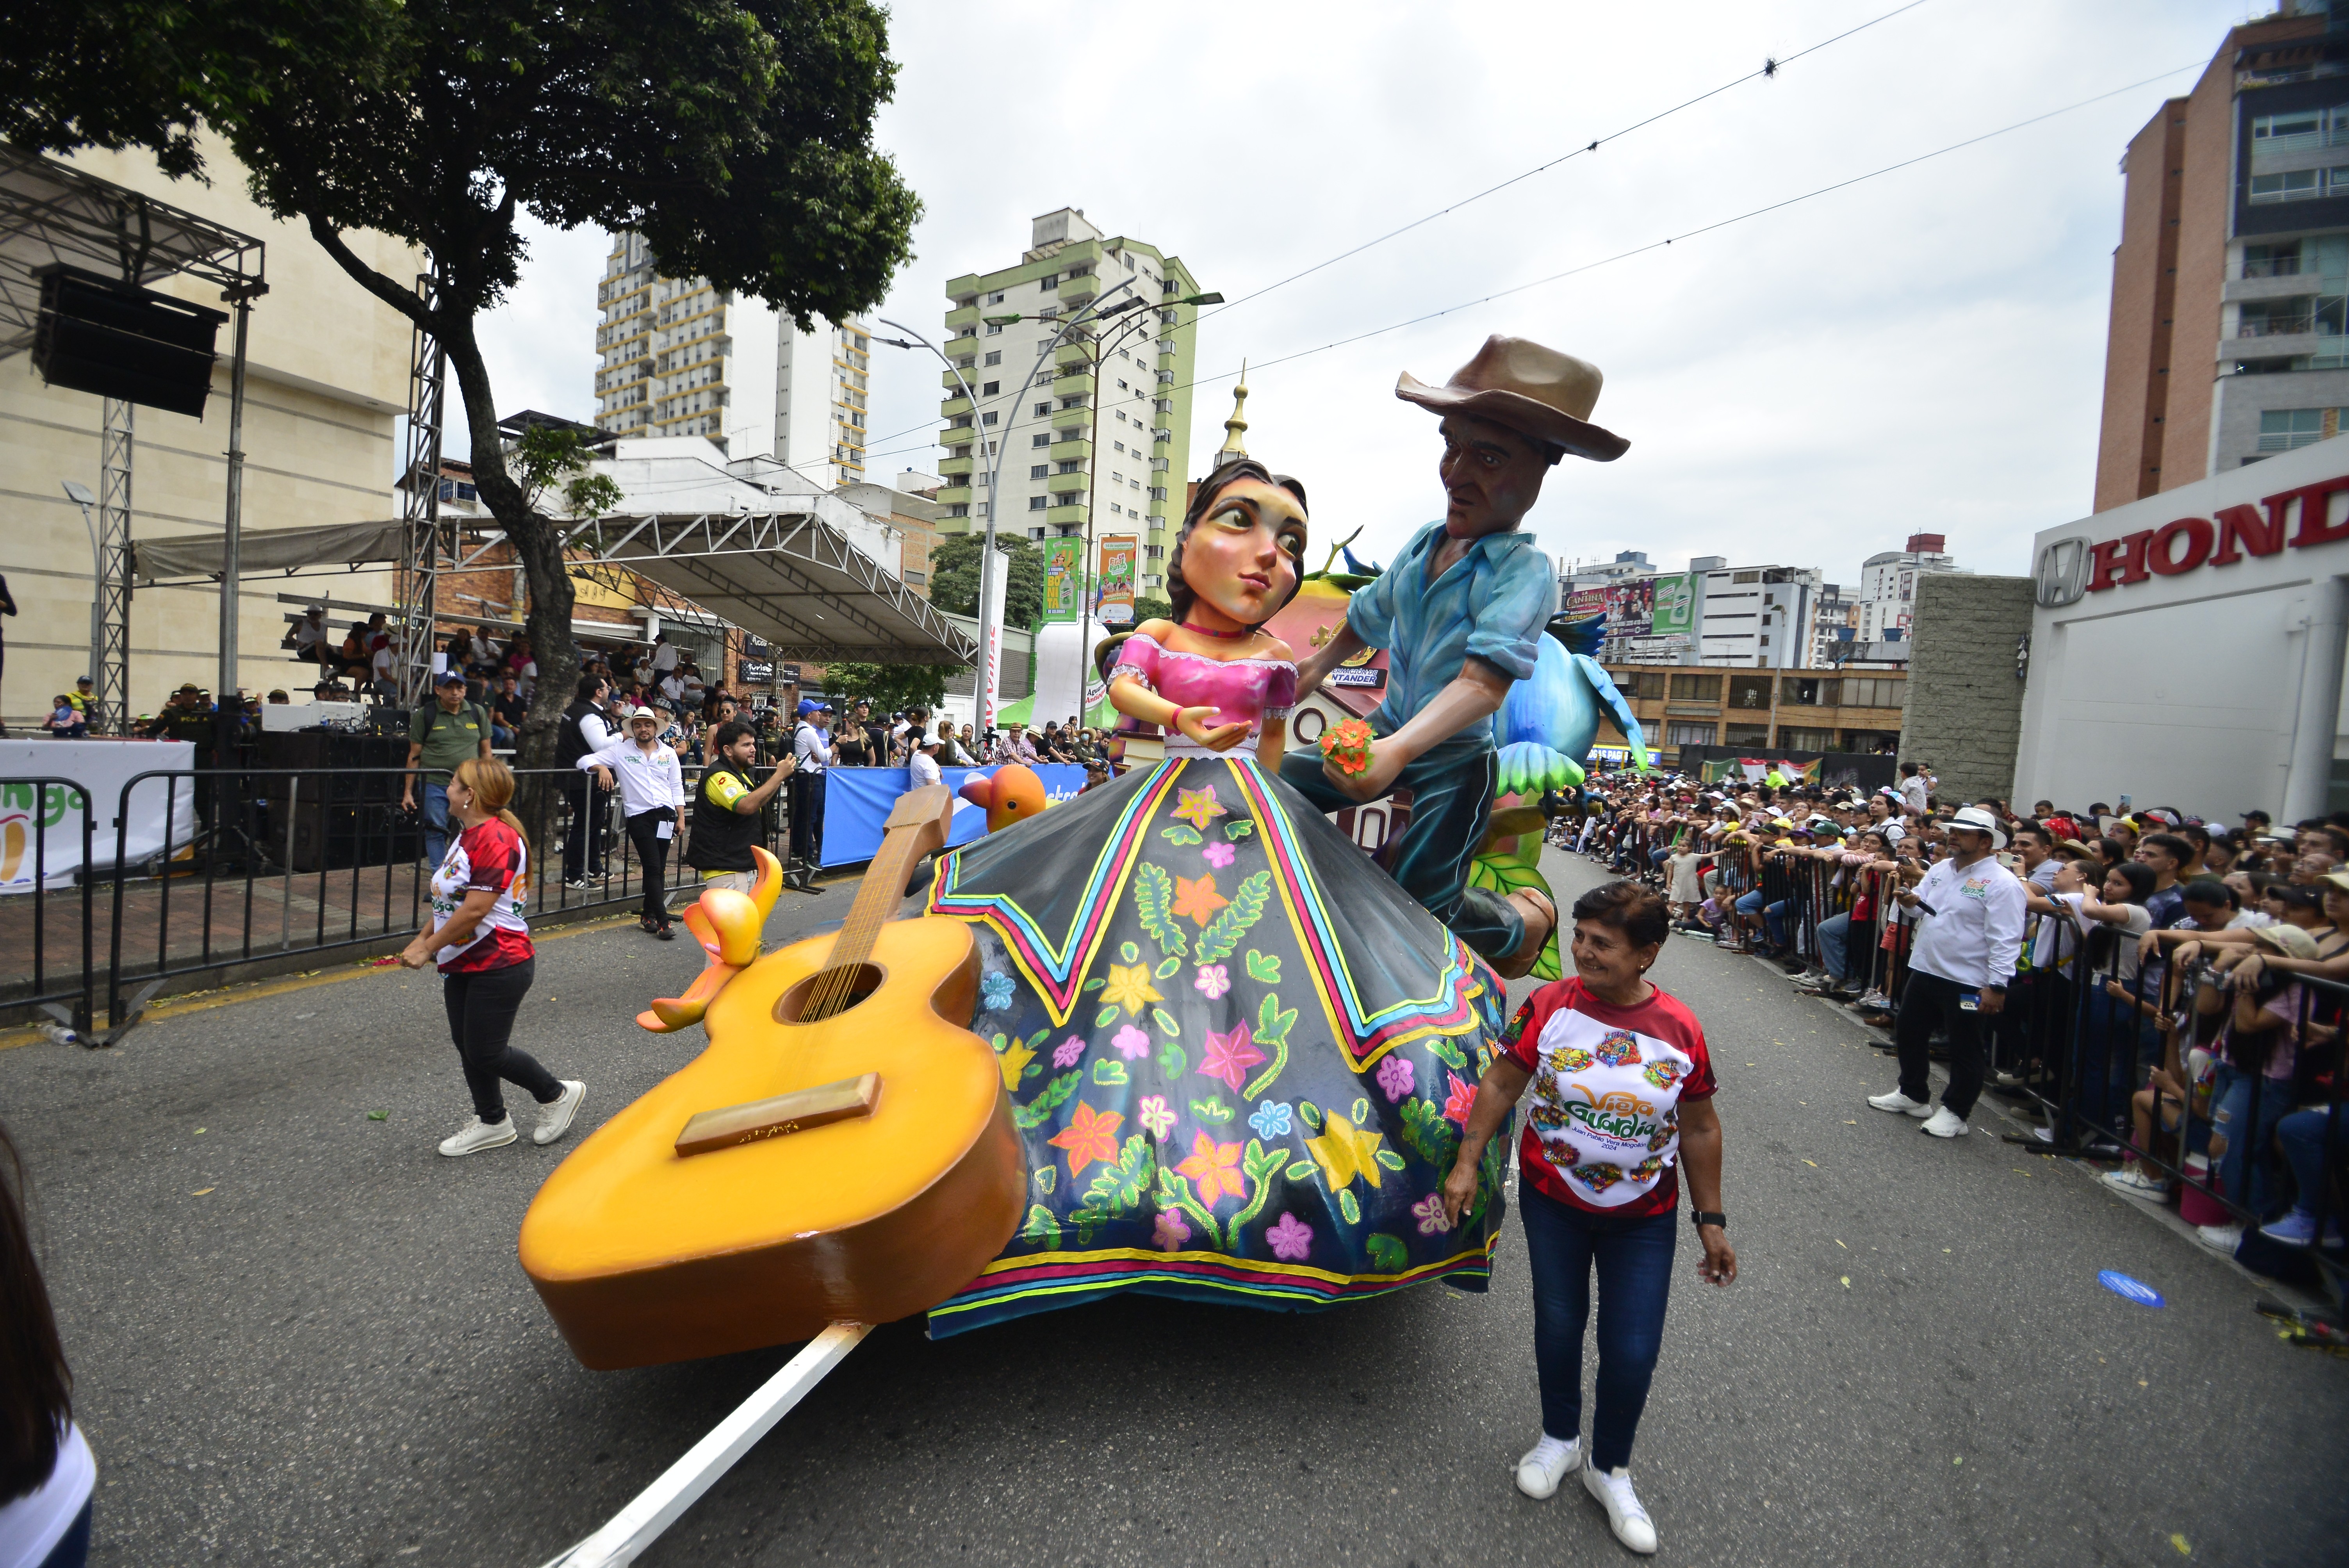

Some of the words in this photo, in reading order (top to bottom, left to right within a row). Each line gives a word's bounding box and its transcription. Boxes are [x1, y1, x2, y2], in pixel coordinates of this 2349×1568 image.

[1110, 561, 1126, 571] Bonita
[1048, 576, 1060, 586] BO
[1047, 587, 1058, 597] NI
[1047, 598, 1059, 608] TA
[1567, 593, 1603, 607] CANTINA
[1331, 674, 1377, 682] NTANDER
[1587, 749, 1607, 759] OGAS
[1572, 1126, 1586, 1136] Juan
[1586, 1132, 1604, 1142] Pablo
[1606, 1138, 1620, 1147] Vera
[1621, 1141, 1646, 1149] Mogollón
[1601, 1142, 1617, 1151] 2024
